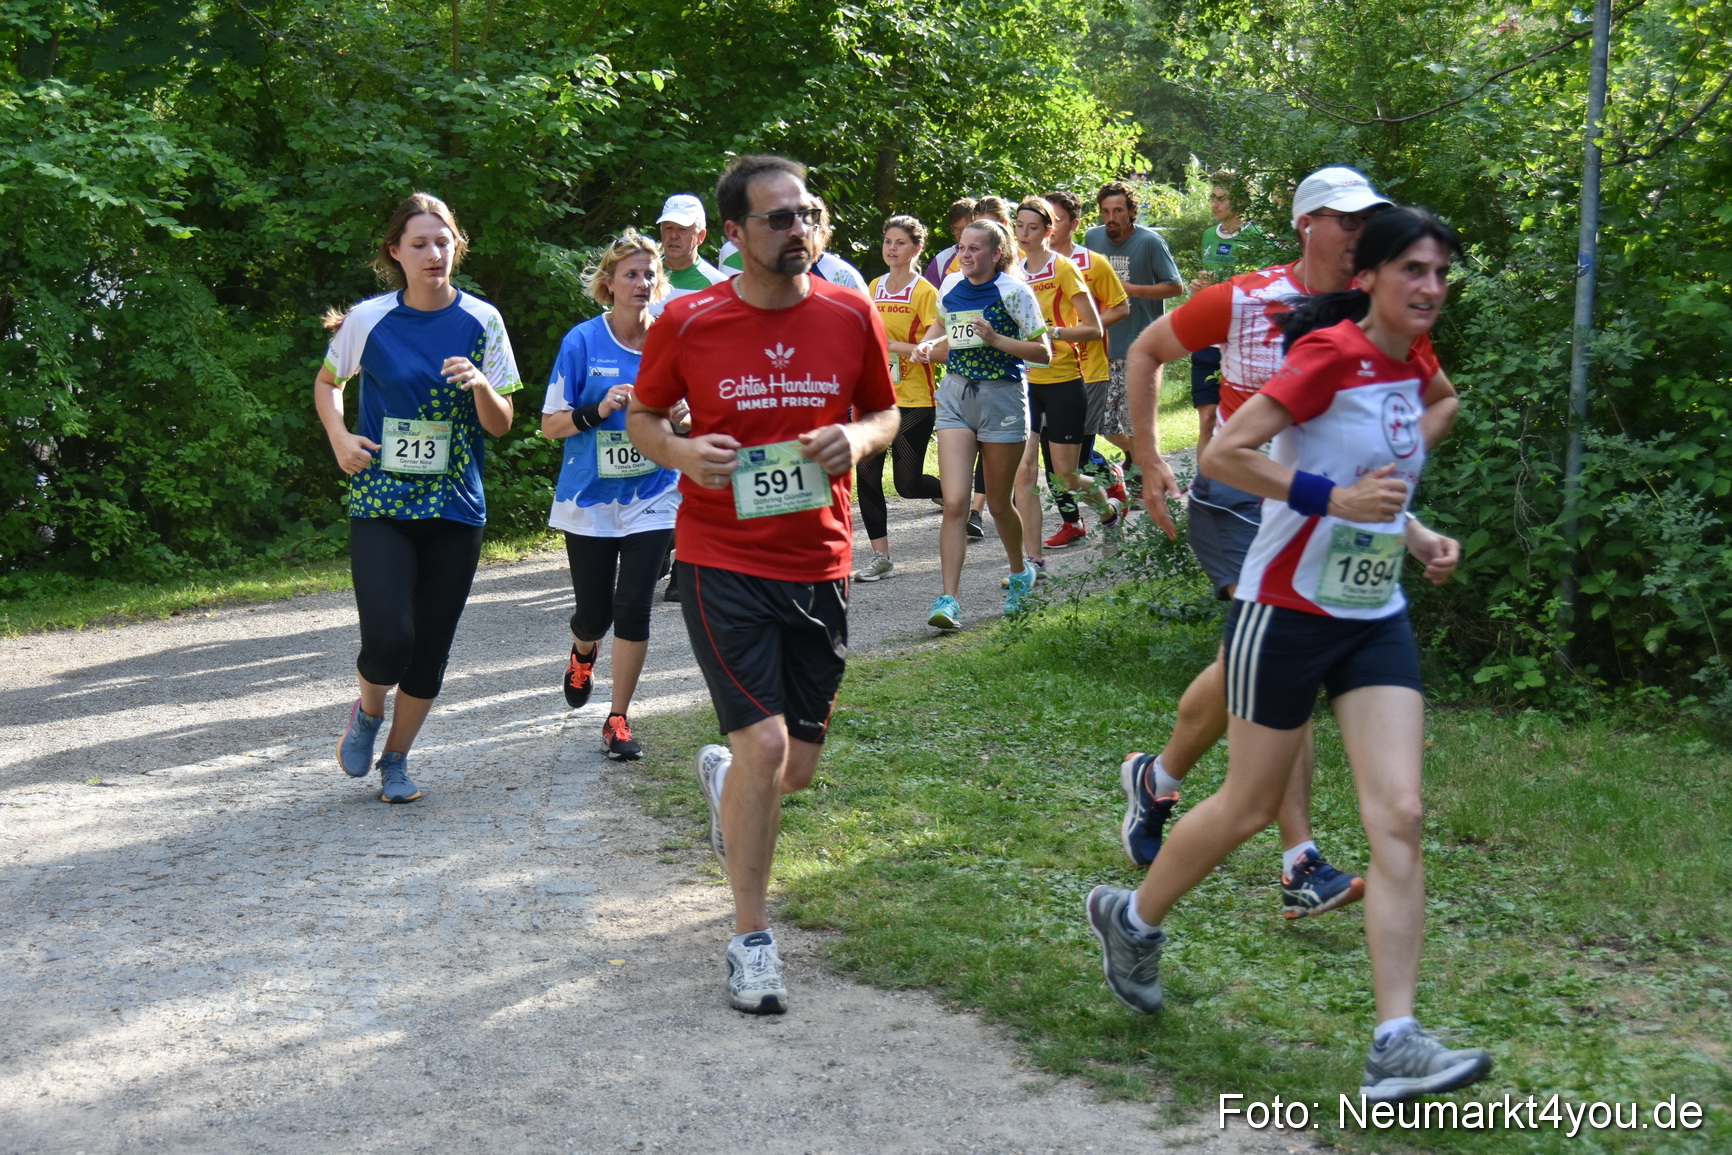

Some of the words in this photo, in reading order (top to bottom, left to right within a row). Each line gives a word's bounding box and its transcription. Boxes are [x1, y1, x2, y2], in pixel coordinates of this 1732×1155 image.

[1033, 282, 1056, 292] BÖGL
[887, 304, 911, 313] BÖGL
[951, 324, 974, 339] 276
[718, 374, 768, 399] Echtes
[769, 372, 840, 395] Handwerk
[737, 397, 778, 411] IMMER
[781, 396, 826, 408] FRISCH
[395, 438, 436, 459] 213
[605, 447, 647, 464] 108
[754, 466, 804, 497] 591
[784, 491, 813, 500] Günther
[1337, 555, 1397, 587] 1894
